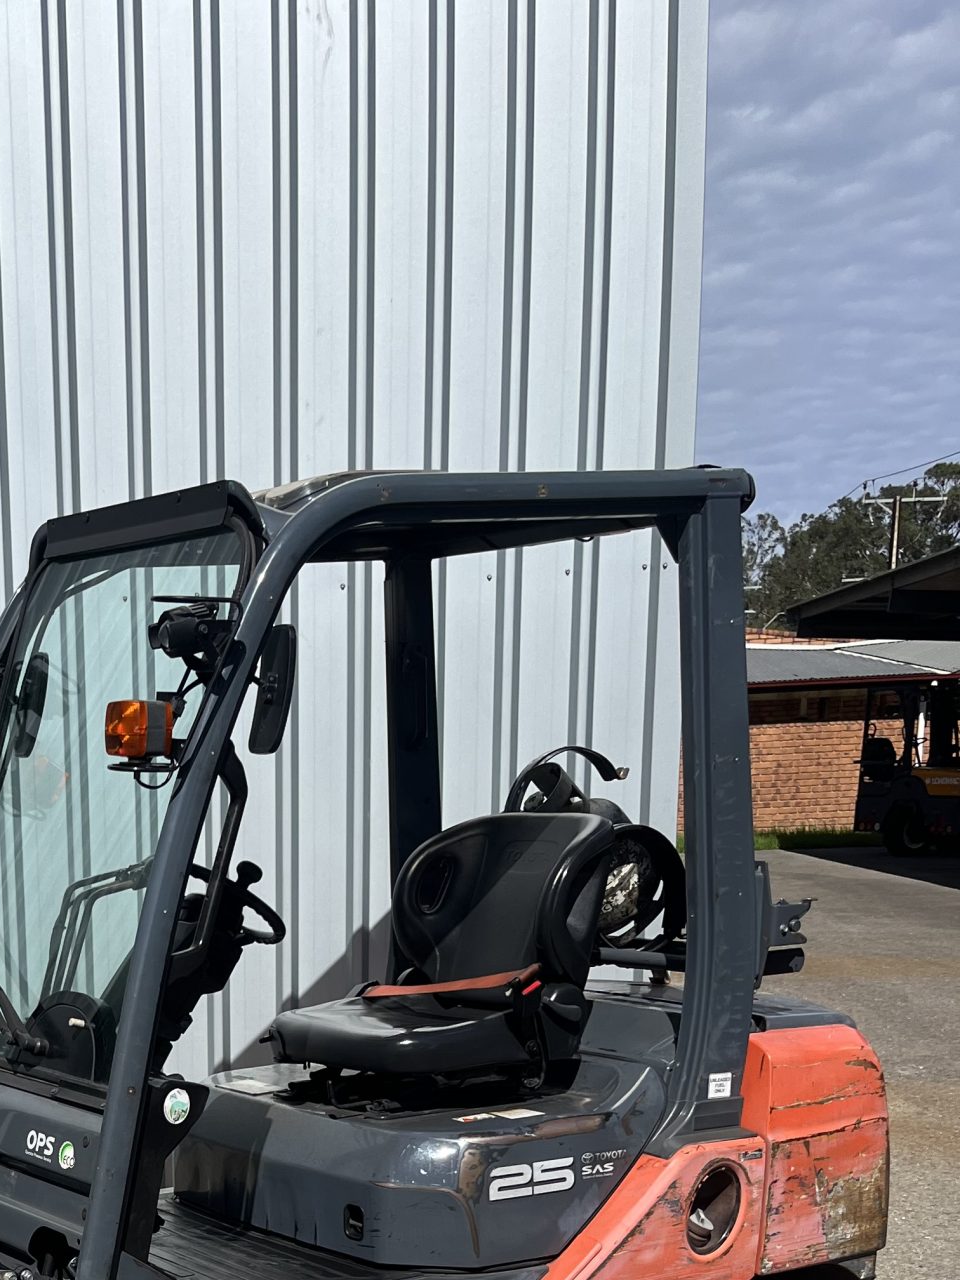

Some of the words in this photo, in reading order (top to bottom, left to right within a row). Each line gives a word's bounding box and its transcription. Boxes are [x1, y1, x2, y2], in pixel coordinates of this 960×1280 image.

[26, 1129, 56, 1156] OPS
[489, 1156, 575, 1201] 25
[581, 1162, 614, 1175] SAS
